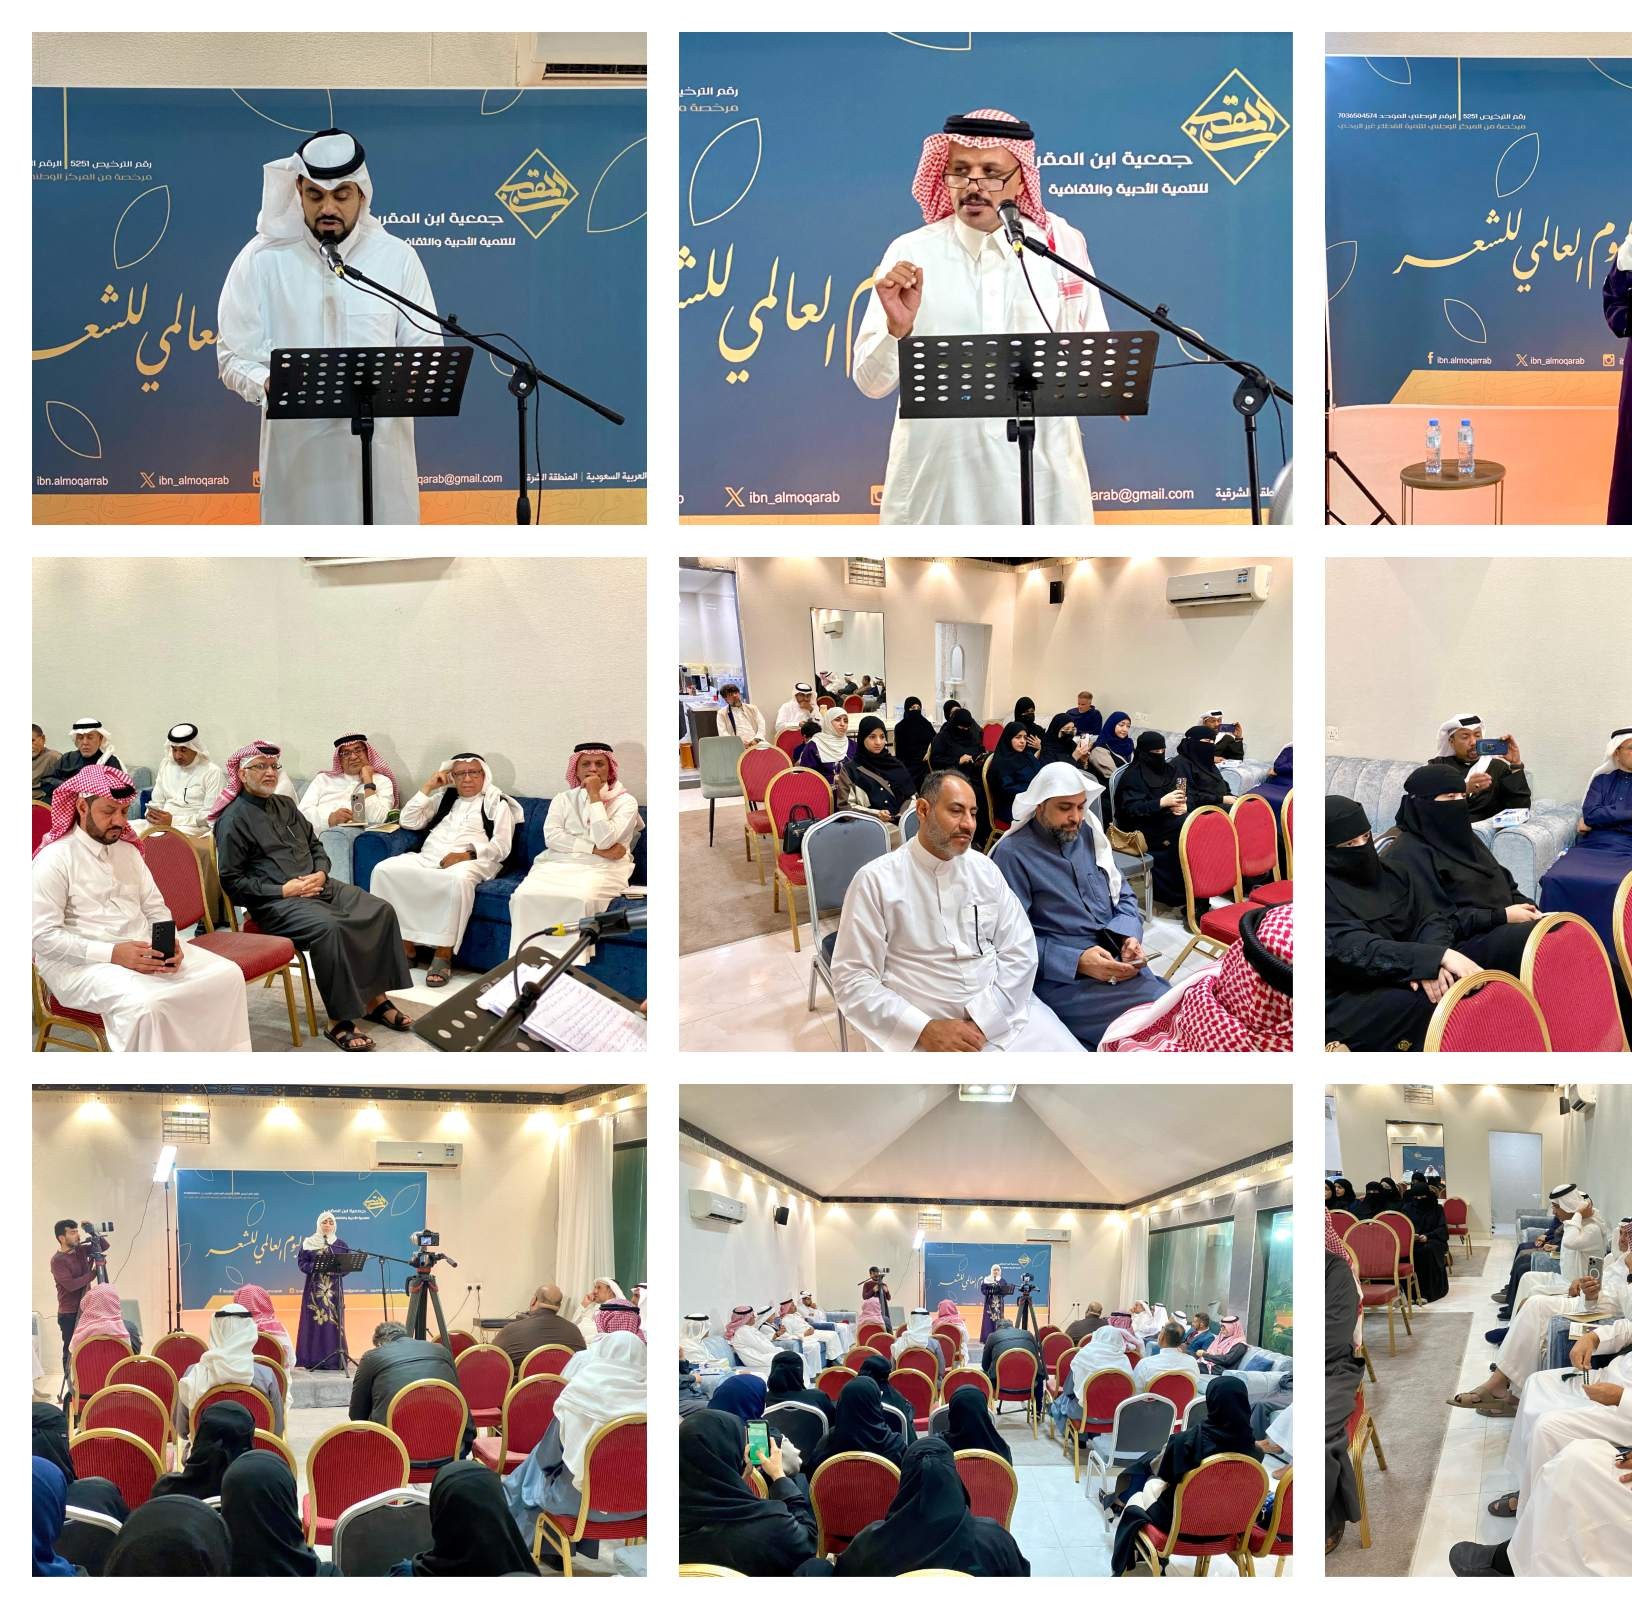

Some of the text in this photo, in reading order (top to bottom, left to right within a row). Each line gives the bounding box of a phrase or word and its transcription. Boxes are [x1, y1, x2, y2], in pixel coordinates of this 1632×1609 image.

[716, 86, 738, 97] رقم
[690, 103, 739, 113] مرخصة
[92, 160, 132, 169] الترخيص
[135, 160, 152, 169] رقم
[1036, 151, 1193, 169] جمعية ابن المقر
[1049, 183, 1209, 197] للتنمية الأدبية والثقافية
[378, 212, 504, 227] جمعية ابن المقر
[444, 237, 477, 248] الأدبية
[479, 237, 516, 247] للتنمية
[1392, 207, 1523, 275] للشعر
[1512, 215, 1583, 293] العالمي
[1436, 355, 1492, 366] ibn.almoqarrab
[1530, 355, 1585, 366] ibn_almoqarab
[36, 476, 108, 487] ibn.almoqarrab
[158, 475, 229, 488] ibn_almoqarab
[417, 473, 503, 486] qarab@gmail.com
[548, 472, 578, 482] المنطقة
[586, 472, 620, 482] السعودية
[749, 491, 840, 505] ibn_almoqarab
[1091, 488, 1194, 502] arab@gmail.com
